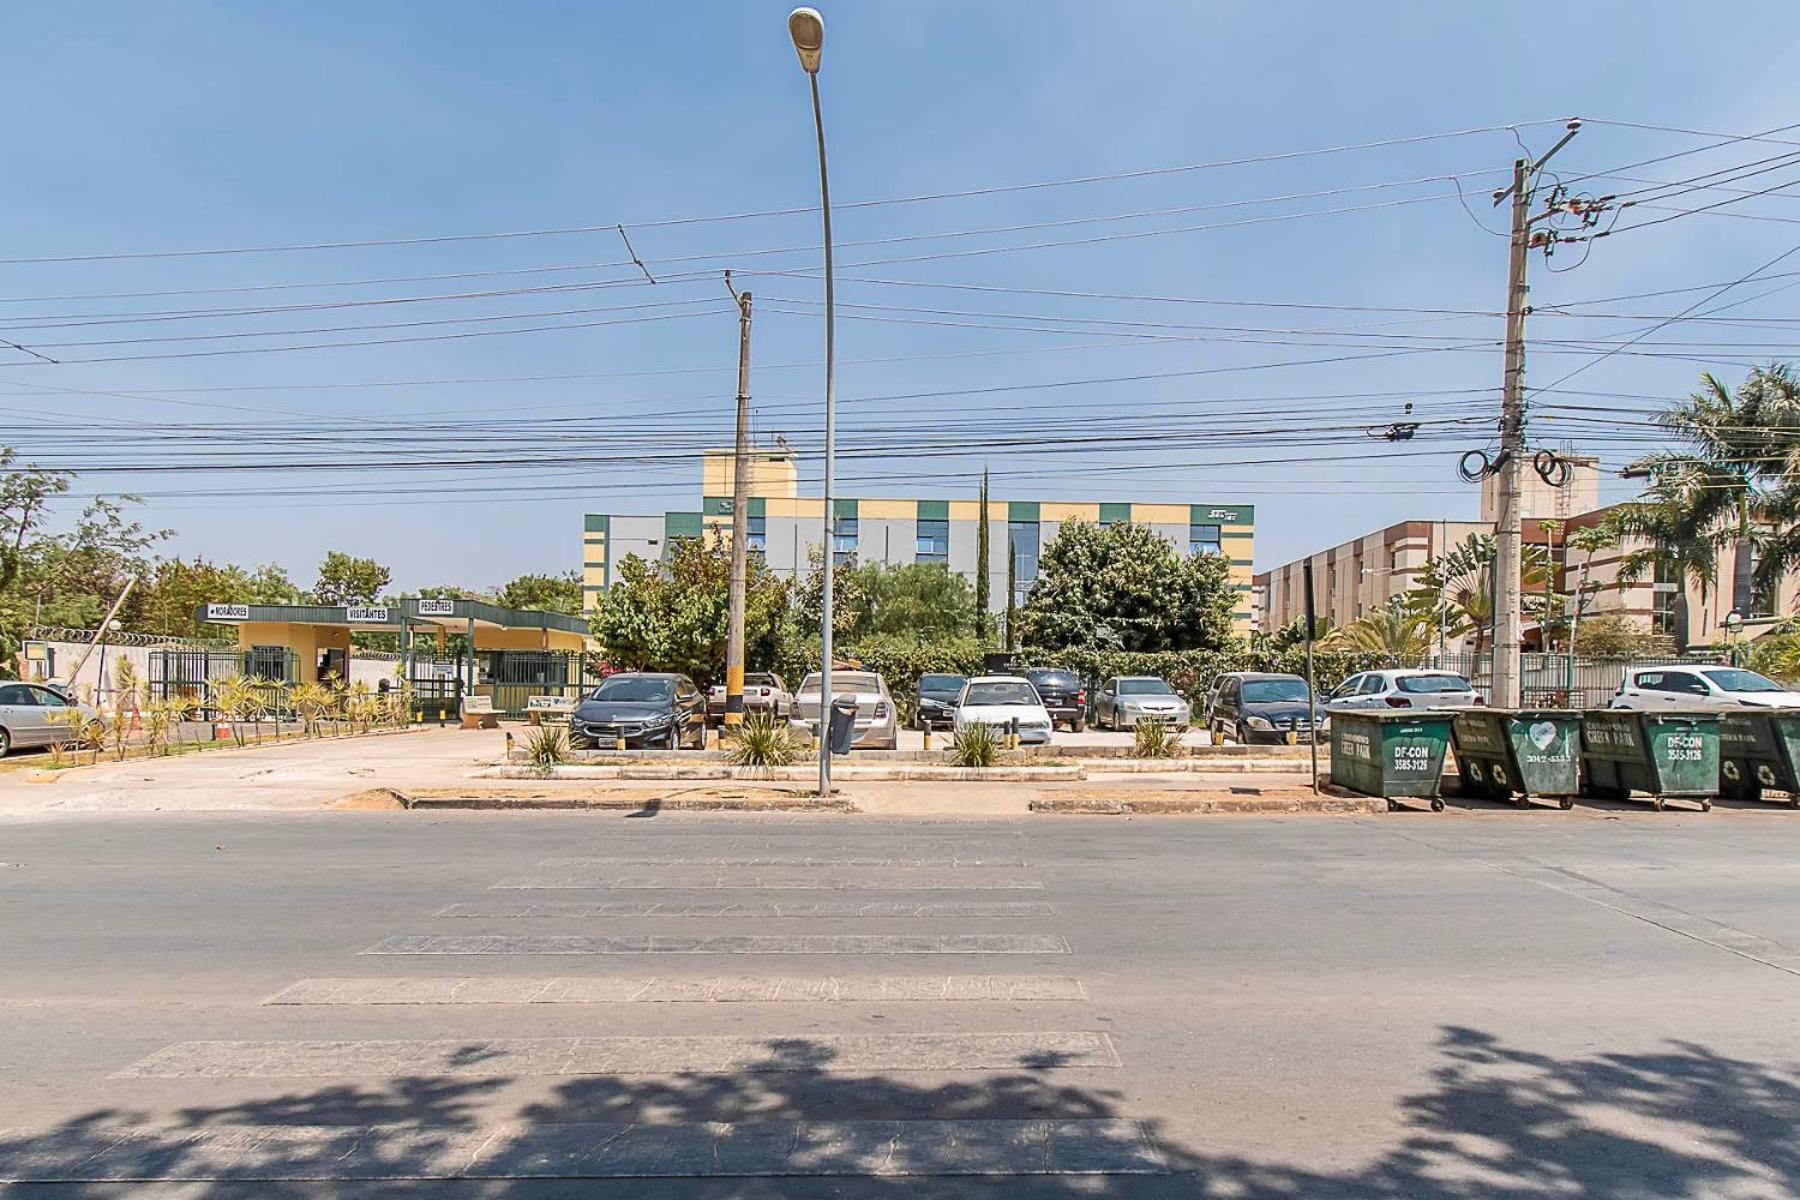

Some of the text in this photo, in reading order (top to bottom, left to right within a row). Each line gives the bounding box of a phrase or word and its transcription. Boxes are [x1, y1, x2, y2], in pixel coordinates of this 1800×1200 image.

[420, 600, 453, 612] PEDESTRES
[348, 608, 386, 619] VISITANTES
[1666, 736, 1702, 748] DF-CON
[1394, 746, 1429, 758] DF-CON
[1394, 760, 1428, 771] 3585-3126
